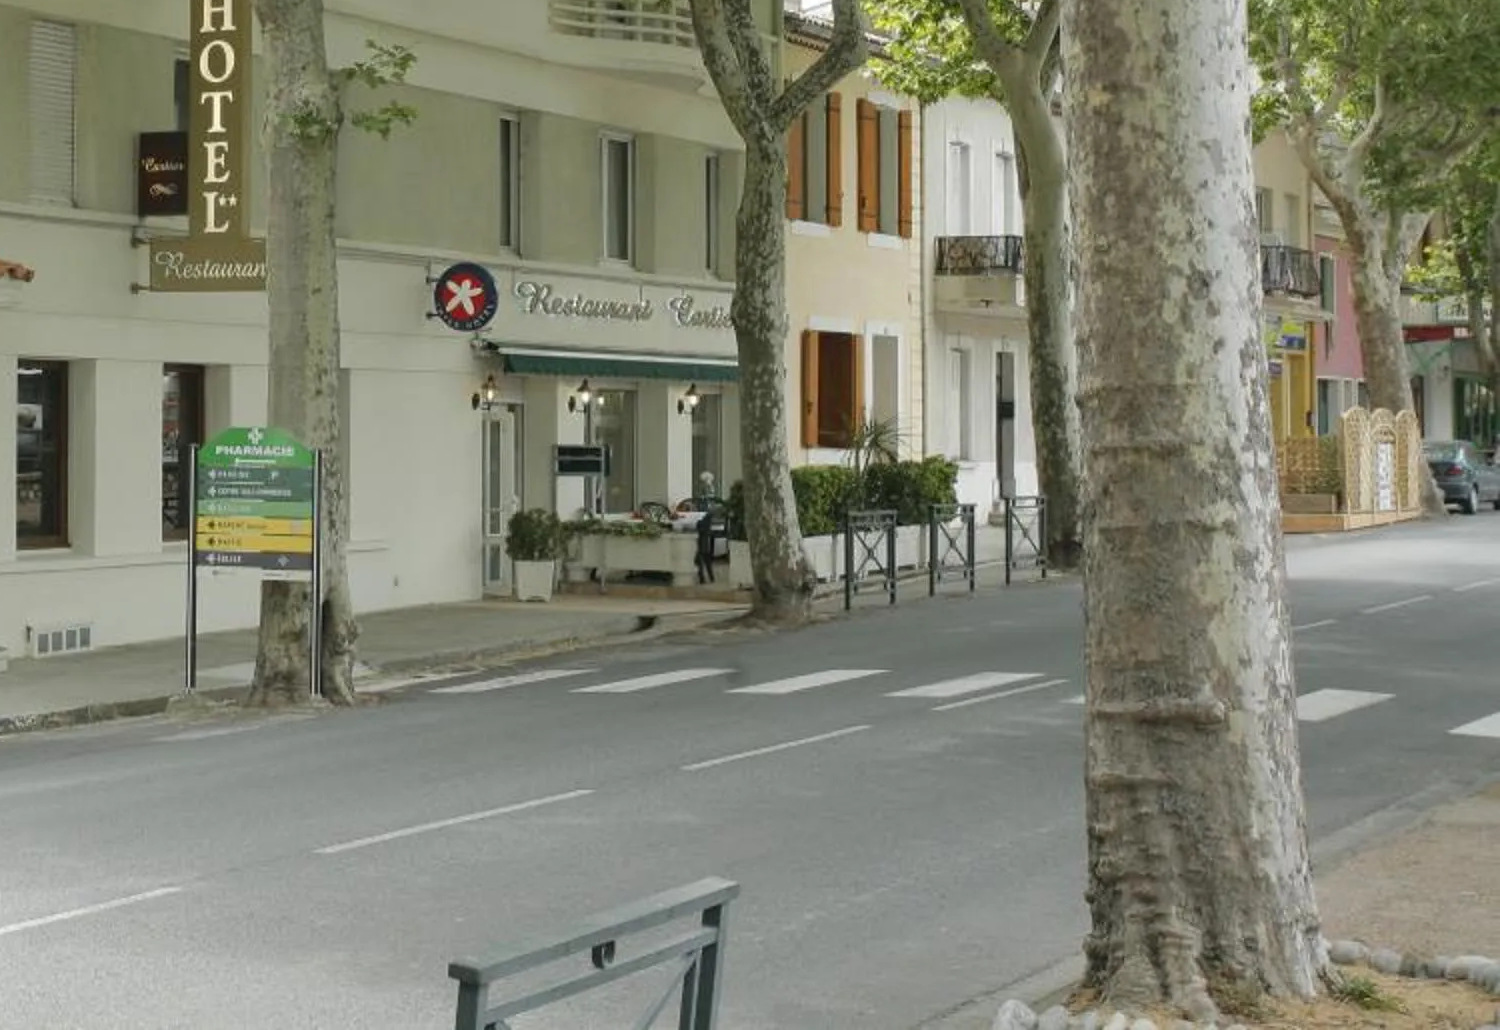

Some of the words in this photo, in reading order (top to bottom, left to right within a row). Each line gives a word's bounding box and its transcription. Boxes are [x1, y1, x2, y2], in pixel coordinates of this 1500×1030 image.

[155, 251, 267, 279] Restauran
[514, 281, 653, 321] Restaurant
[667, 294, 734, 327] Cartie
[214, 445, 295, 457] PHARMACIE
